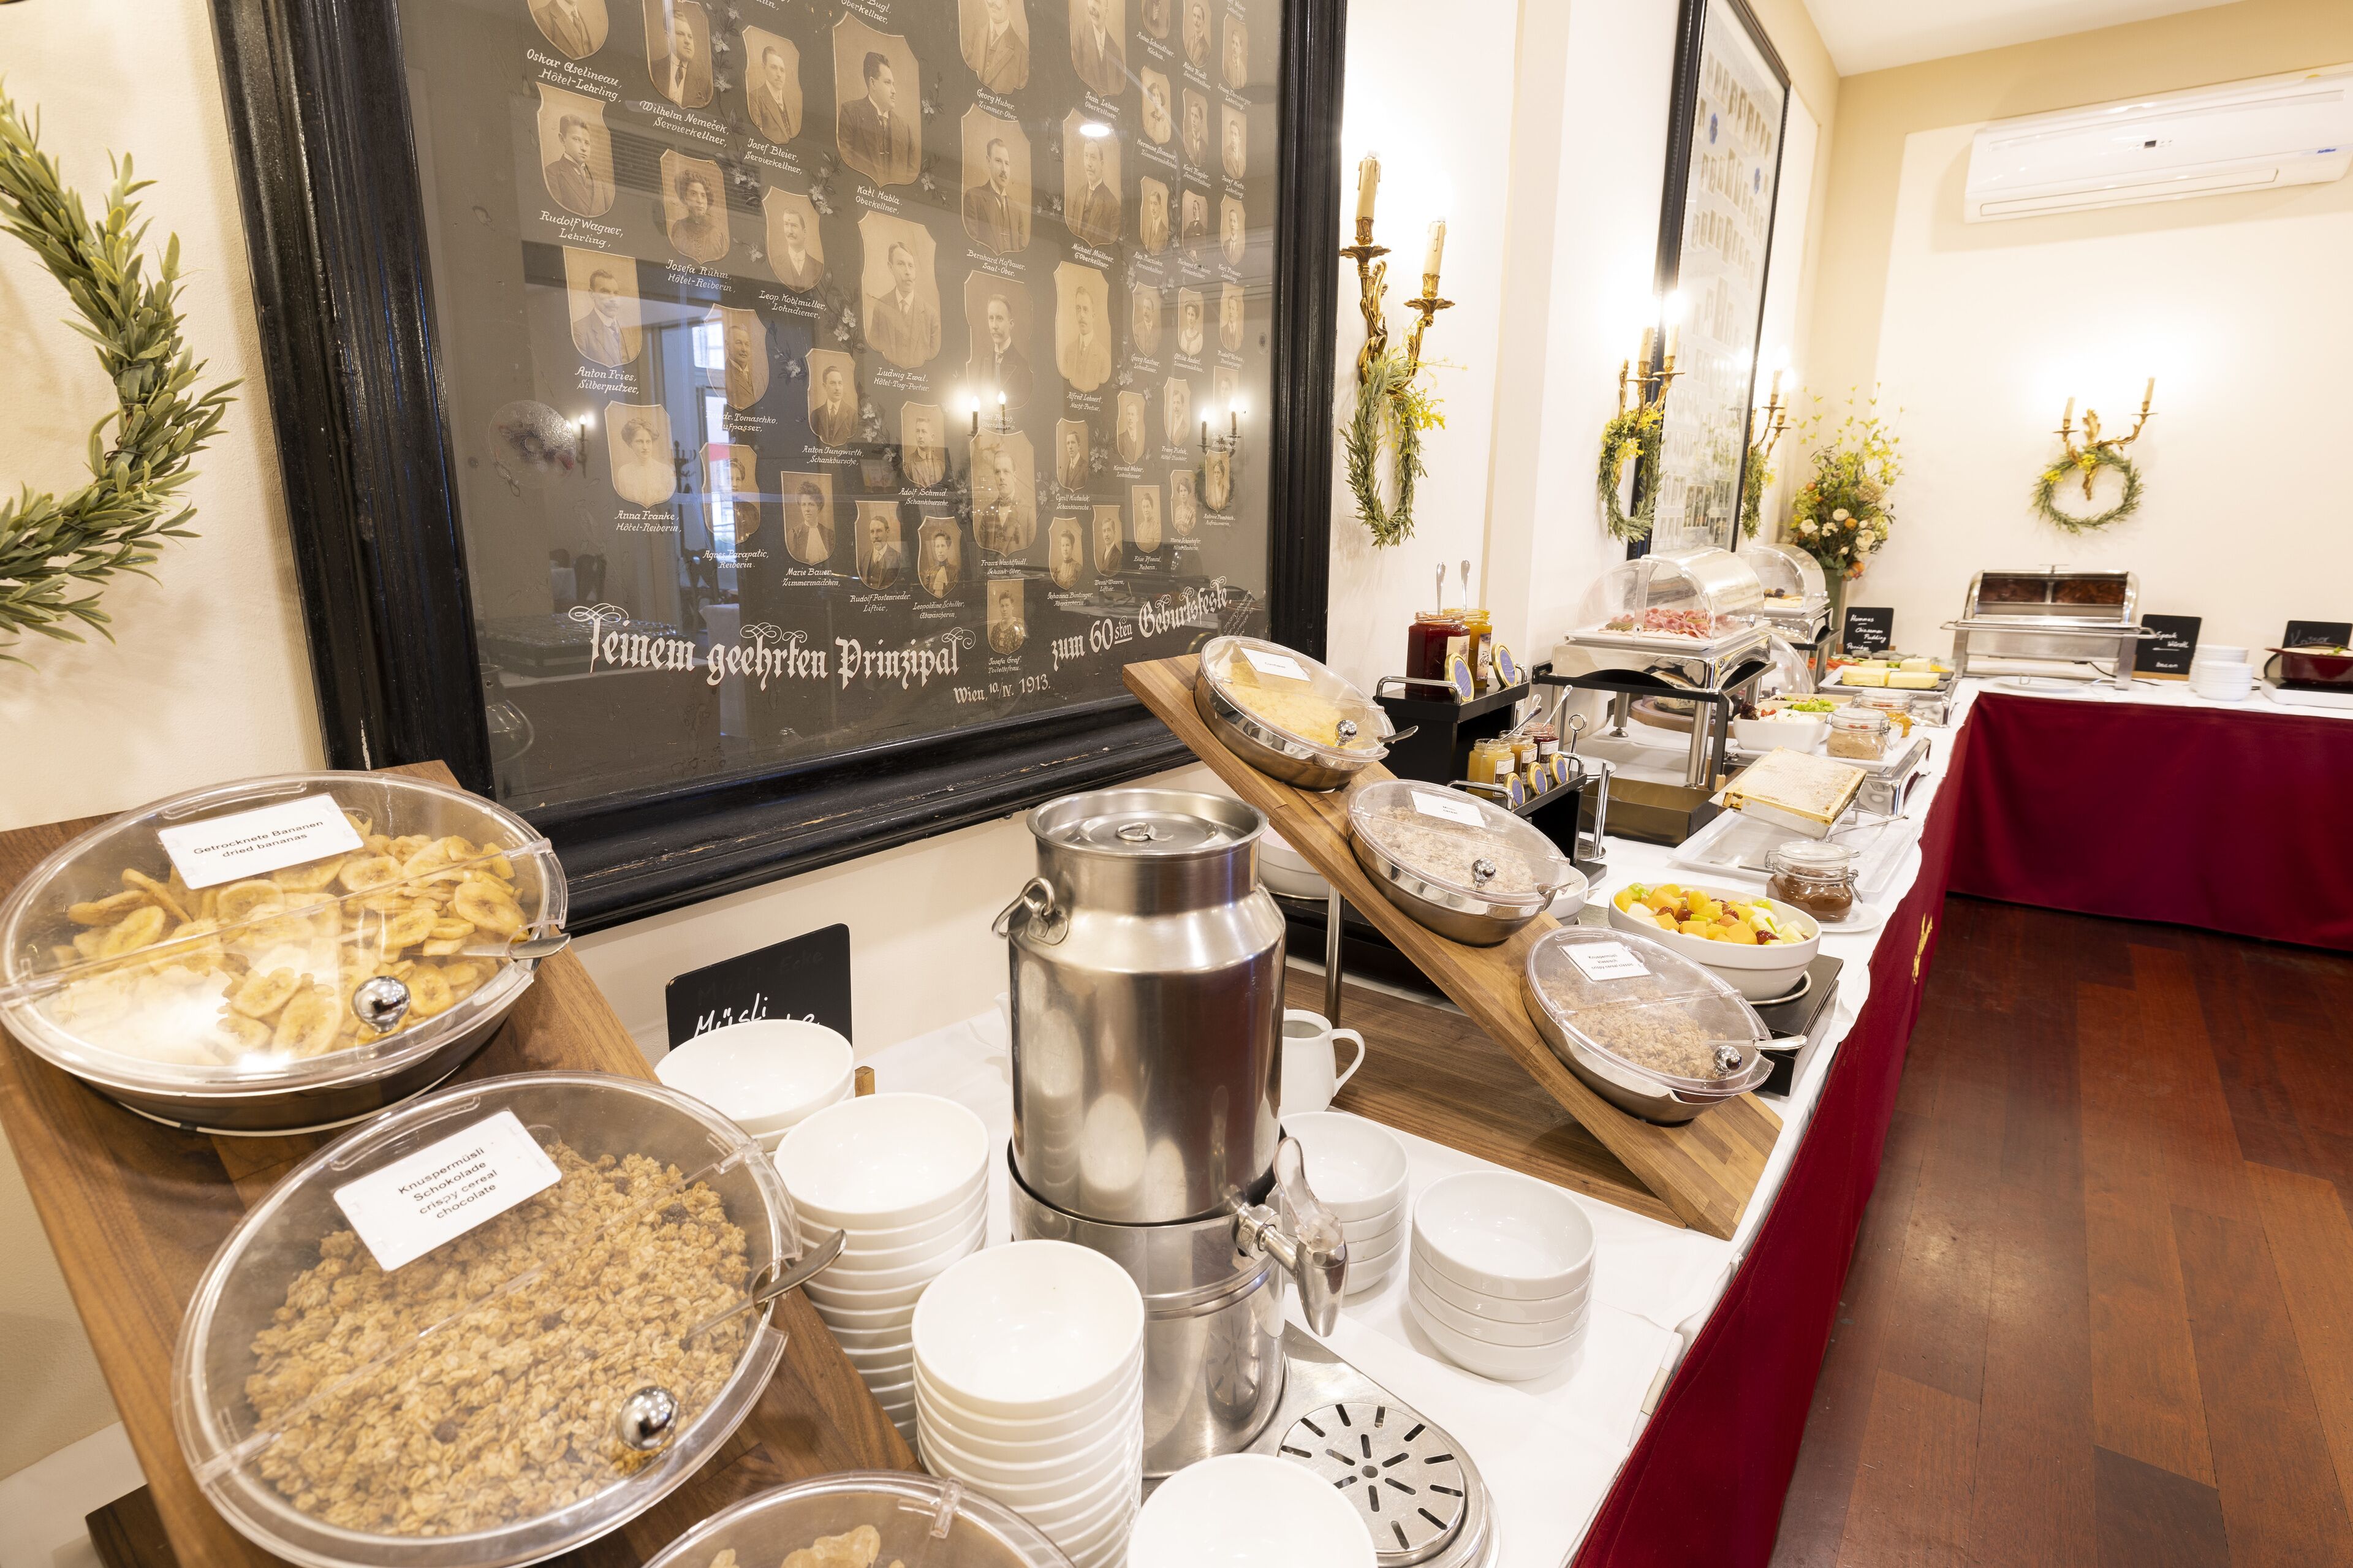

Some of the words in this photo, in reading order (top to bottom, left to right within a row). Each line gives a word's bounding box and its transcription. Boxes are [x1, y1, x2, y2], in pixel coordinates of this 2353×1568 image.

[527, 48, 561, 67] Oskar
[538, 68, 621, 103] Hôtel-Lehrling,
[977, 88, 995, 105] Georg
[995, 96, 1015, 111] Huber,
[1085, 91, 1099, 104] Jean
[639, 100, 682, 121] Wilhelm
[684, 113, 730, 135] Nemeček,
[653, 116, 727, 148] Servierkellner,
[748, 137, 770, 155] Josef
[744, 151, 803, 175] Servierkellner,
[855, 195, 900, 215] Oberkellner,
[539, 210, 581, 232] Rudolf
[582, 218, 624, 238] Wagner,
[558, 228, 612, 248] Lehrling,
[966, 249, 999, 265] Bernhard
[1071, 243, 1092, 256] Michael
[665, 259, 696, 275] Josefa
[698, 265, 733, 281] Rühm,
[667, 273, 736, 294] Hôtel-Reiberin,
[759, 290, 781, 303] Leop.
[771, 303, 820, 320] Lohndiener,
[575, 366, 607, 379] Anton
[607, 369, 637, 382] Fries,
[876, 367, 905, 381] Ludwig
[576, 379, 640, 395] Silberputzer,
[1066, 392, 1083, 402] Alfred
[733, 412, 779, 425] Tomaschko,
[801, 445, 824, 454] Anton
[824, 447, 865, 458] Jungwirth,
[806, 453, 859, 467] Schankbursche,
[898, 487, 918, 498] Adolf
[1055, 493, 1070, 502] Cyrill
[904, 497, 950, 507] Schankbursche,
[614, 510, 641, 520] Anna
[642, 510, 680, 521] Franke,
[615, 522, 682, 534] Hôtel-Reiberin,
[702, 549, 726, 561] Agnes
[718, 560, 756, 569] Reiberin.
[786, 567, 807, 576] Marie
[782, 577, 841, 588] Zimmermädchen,
[849, 594, 874, 605] Rudolf
[1047, 591, 1069, 600] Johanna
[912, 601, 942, 612] Leopoldine
[1863, 634, 1887, 644] Pudding
[706, 621, 829, 691] geehrten
[835, 626, 976, 690] Prinzipal
[1051, 635, 1085, 671] zum
[988, 657, 1006, 667] Josefa
[953, 686, 988, 704] Wien,
[1018, 673, 1051, 693] 1913.
[193, 833, 269, 855] Getrocknete
[271, 820, 324, 836] Bananen
[222, 846, 254, 858] dried
[256, 833, 308, 849] bananas
[397, 1147, 486, 1195] Knuspermüsli
[413, 1161, 487, 1202] Schokolade
[419, 1191, 458, 1214] crispy
[461, 1169, 498, 1192] cereal
[436, 1183, 497, 1219] chocolate
